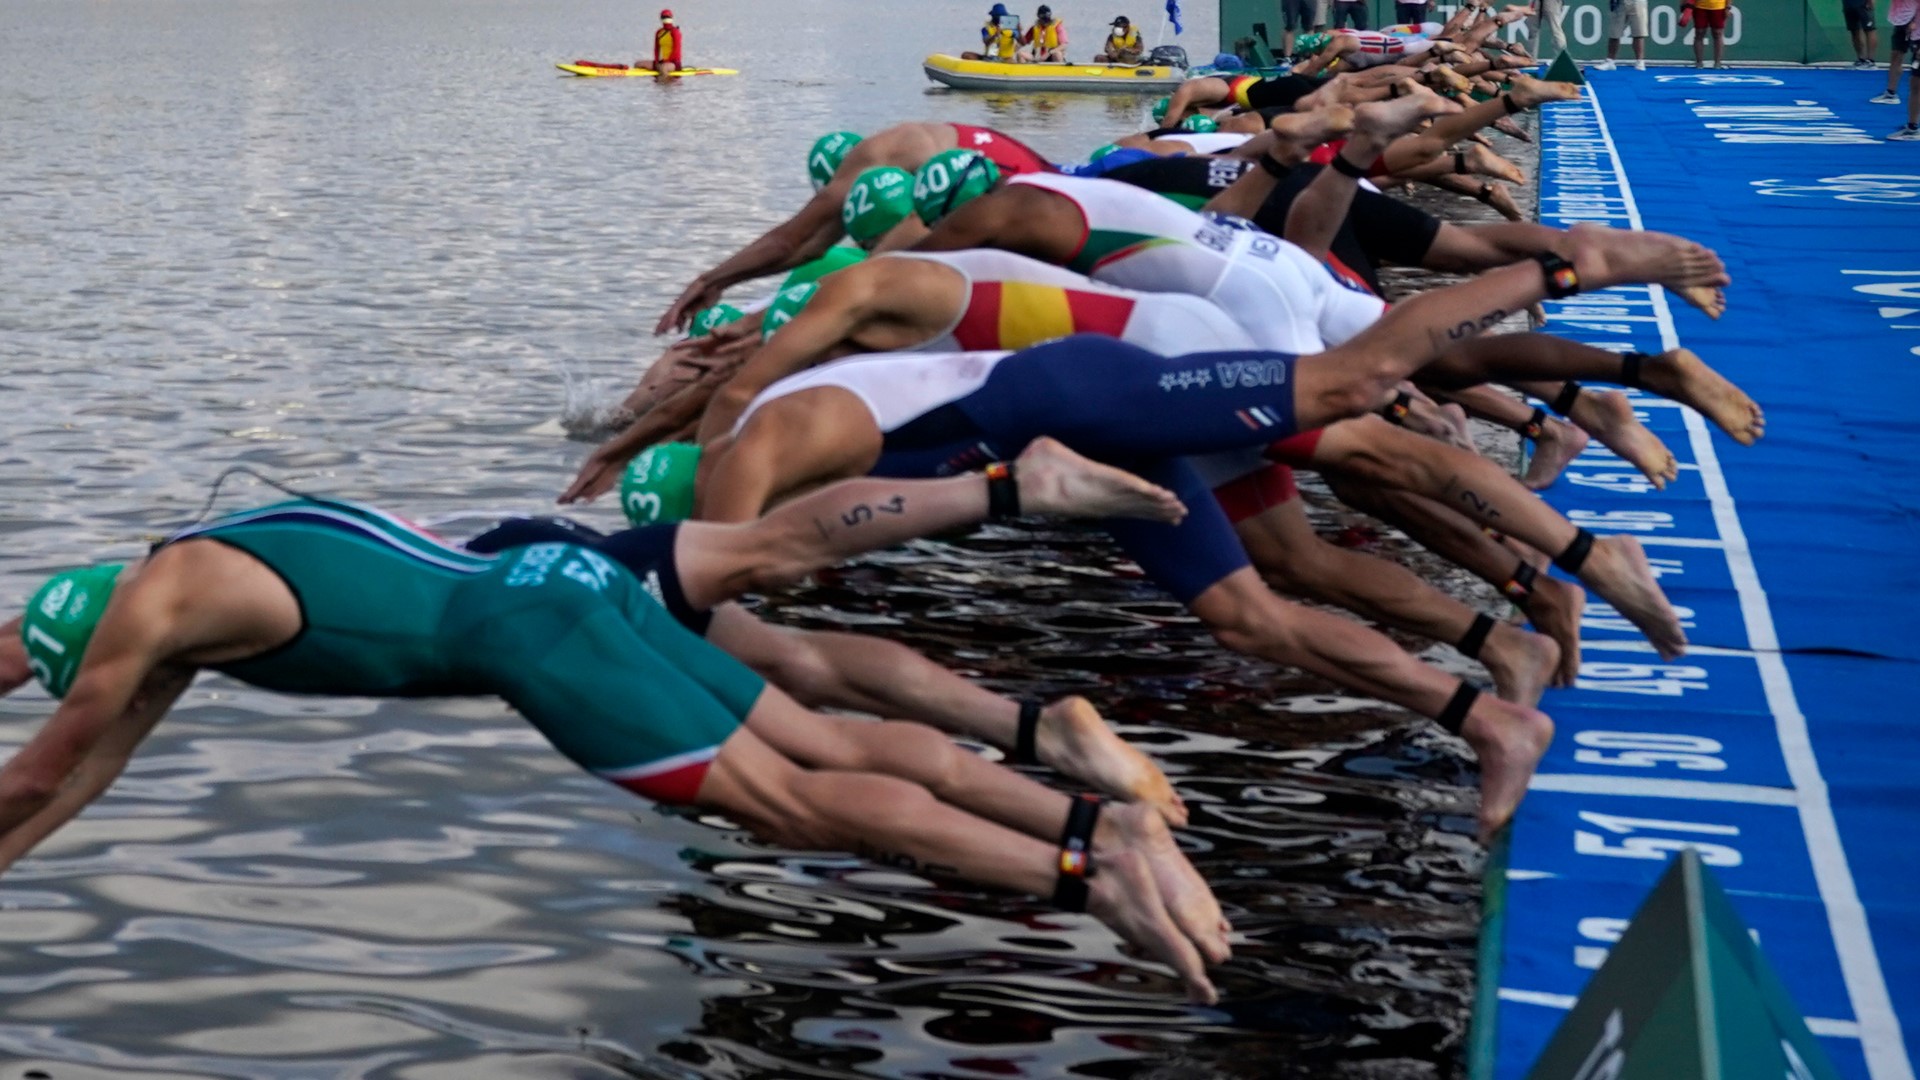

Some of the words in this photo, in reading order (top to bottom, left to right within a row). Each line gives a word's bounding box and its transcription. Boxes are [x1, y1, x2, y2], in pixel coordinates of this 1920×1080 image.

[1215, 359, 1286, 389] USA
[1573, 661, 1711, 697] 49
[1573, 729, 1729, 772] 50
[1573, 810, 1743, 868] 51
